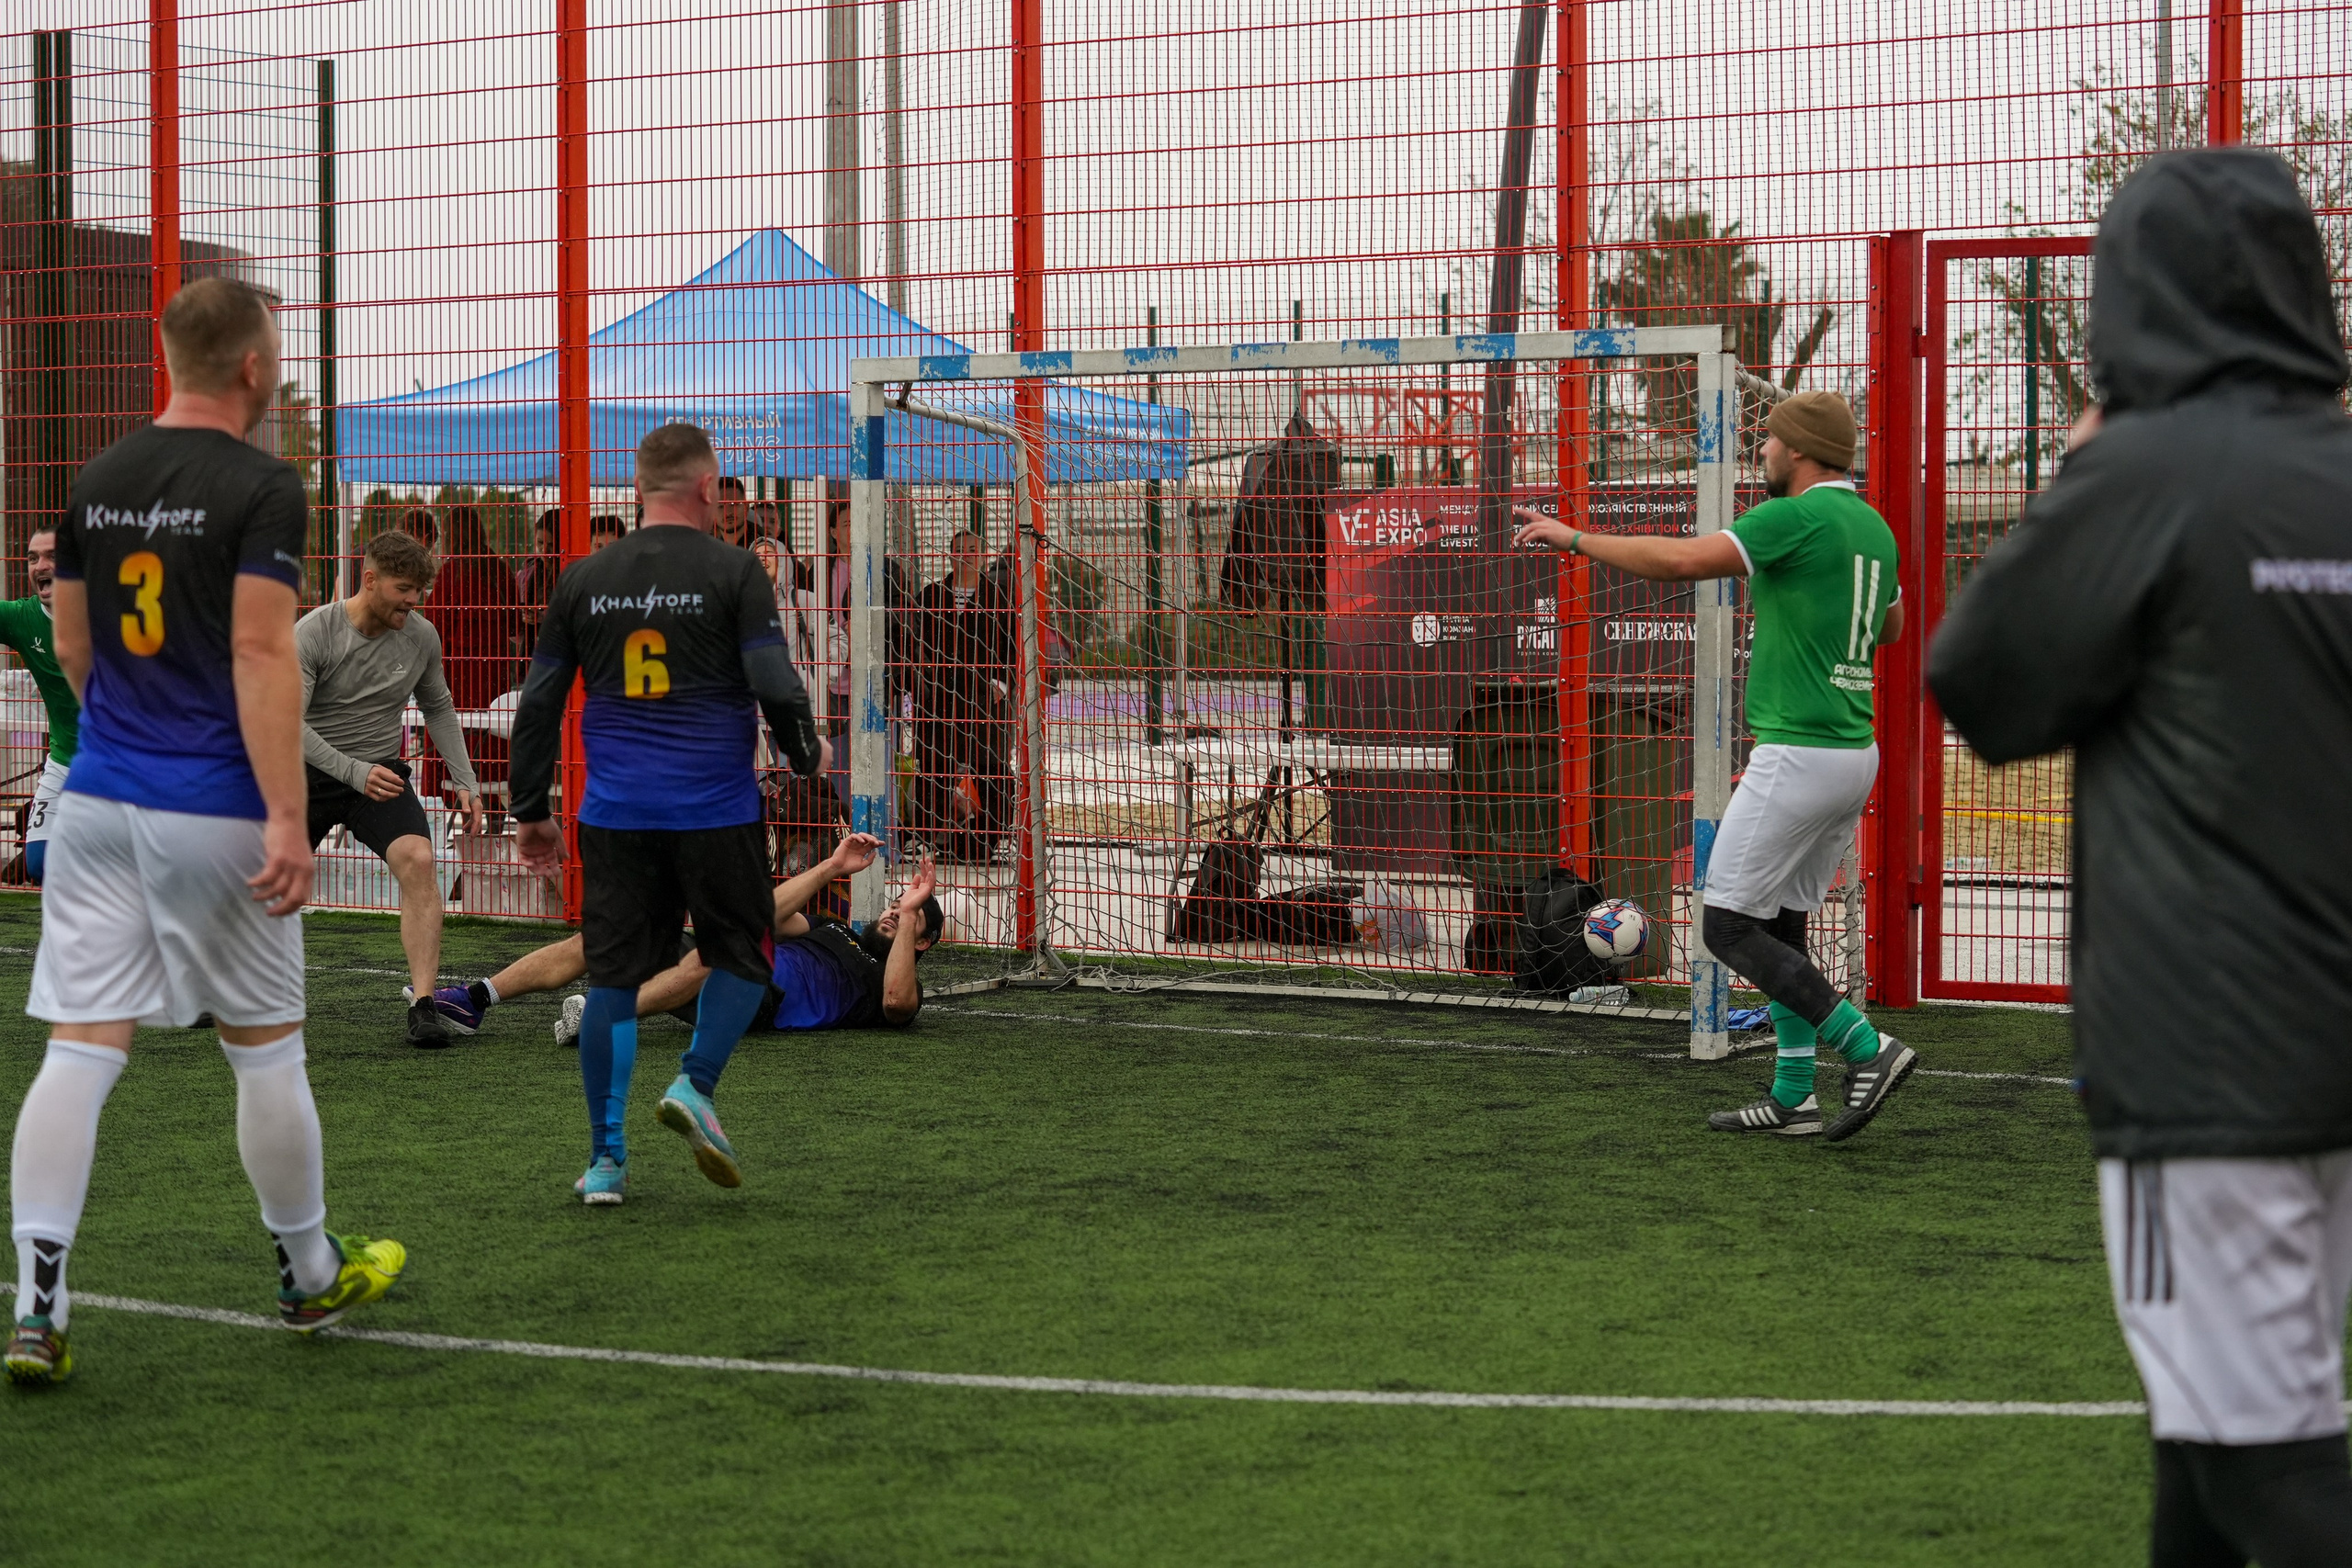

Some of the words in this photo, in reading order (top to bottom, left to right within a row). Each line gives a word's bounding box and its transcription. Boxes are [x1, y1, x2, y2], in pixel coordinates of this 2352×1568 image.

[1375, 508, 1421, 526] ASIA
[1375, 528, 1428, 547] EXPO
[1441, 525, 1459, 535] THE
[1621, 525, 1679, 534] EXHIBITION
[119, 551, 164, 658] 3
[1848, 554, 1881, 662] 11
[624, 627, 671, 699] 6
